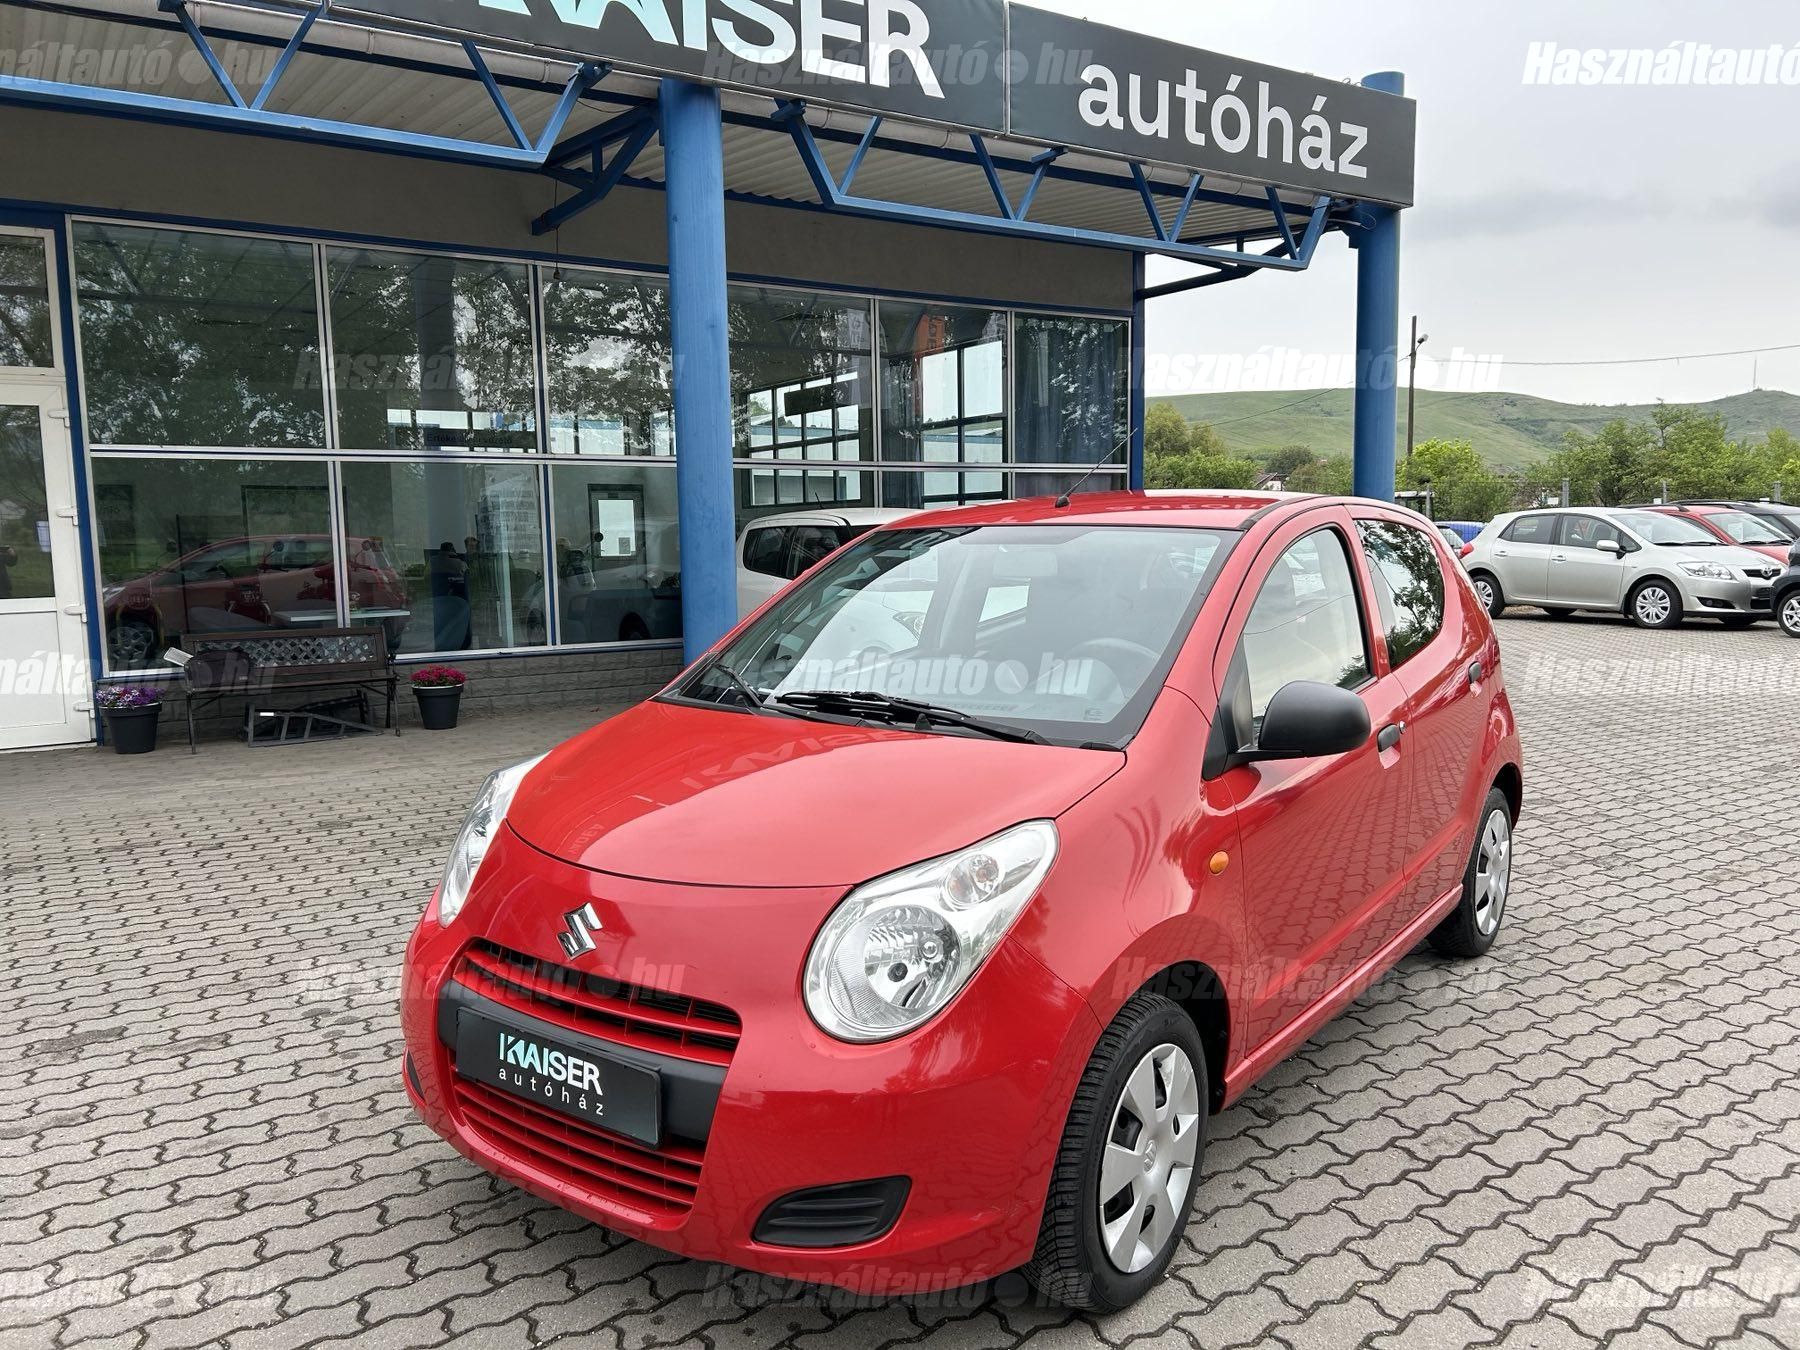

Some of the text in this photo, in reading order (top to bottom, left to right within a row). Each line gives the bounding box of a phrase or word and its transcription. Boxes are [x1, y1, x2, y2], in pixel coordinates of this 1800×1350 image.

[479, 0, 945, 99] SER
[1078, 64, 1368, 179] autóház
[498, 1068, 604, 1117] autóház
[499, 1032, 604, 1097] KAISER
